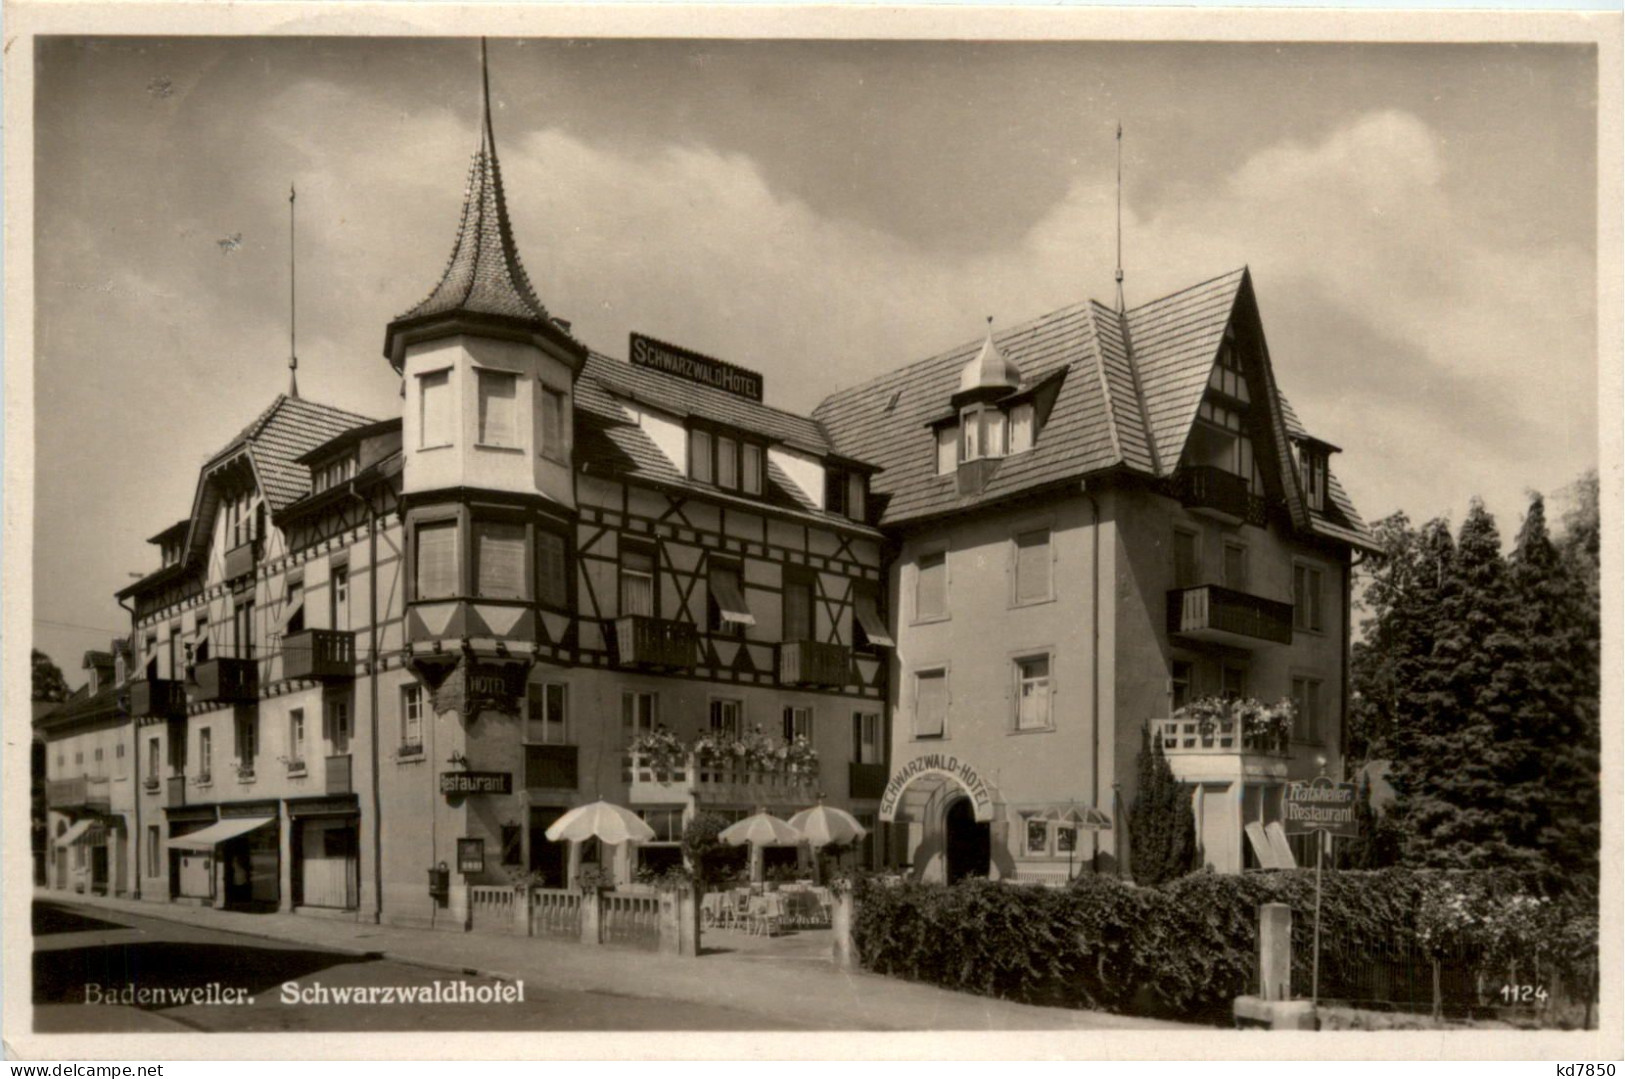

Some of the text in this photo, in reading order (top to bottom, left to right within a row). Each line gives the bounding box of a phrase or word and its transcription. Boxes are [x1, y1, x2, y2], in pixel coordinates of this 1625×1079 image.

[469, 676, 508, 695] HOTEL
[881, 754, 990, 815] SCHWARZWALD-HOTEL
[1289, 803, 1352, 822] Restaurant
